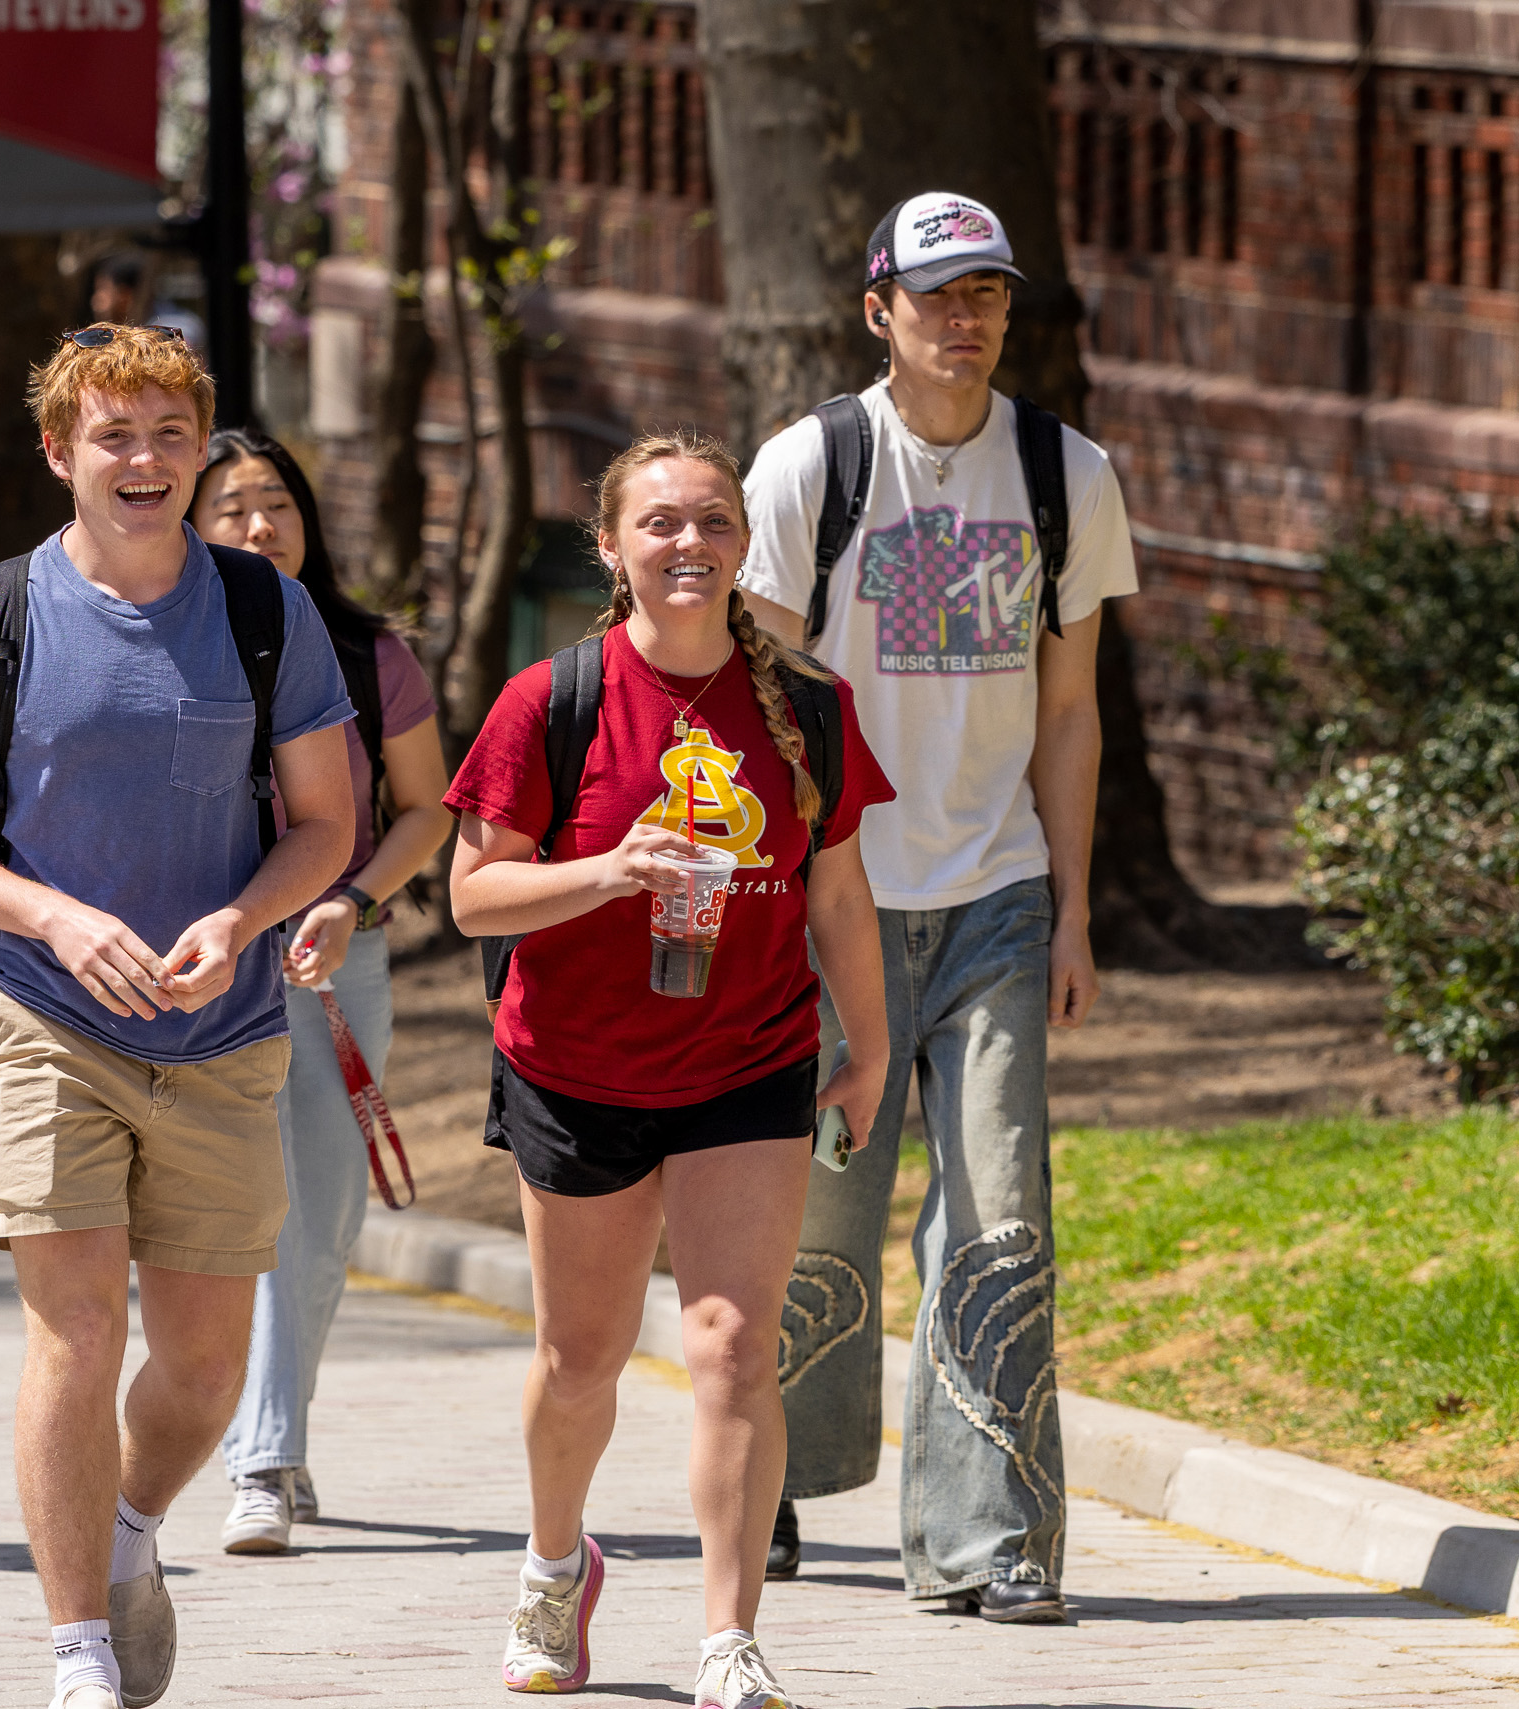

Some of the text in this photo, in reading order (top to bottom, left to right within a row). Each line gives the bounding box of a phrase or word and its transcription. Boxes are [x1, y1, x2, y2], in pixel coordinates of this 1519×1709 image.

[913, 209, 960, 229] speed
[925, 223, 942, 235] of
[919, 232, 954, 248] light
[881, 652, 1027, 671] MUSIC TELEVISION
[710, 884, 727, 908] BI
[727, 879, 788, 894] STATE
[696, 907, 722, 928] GU
